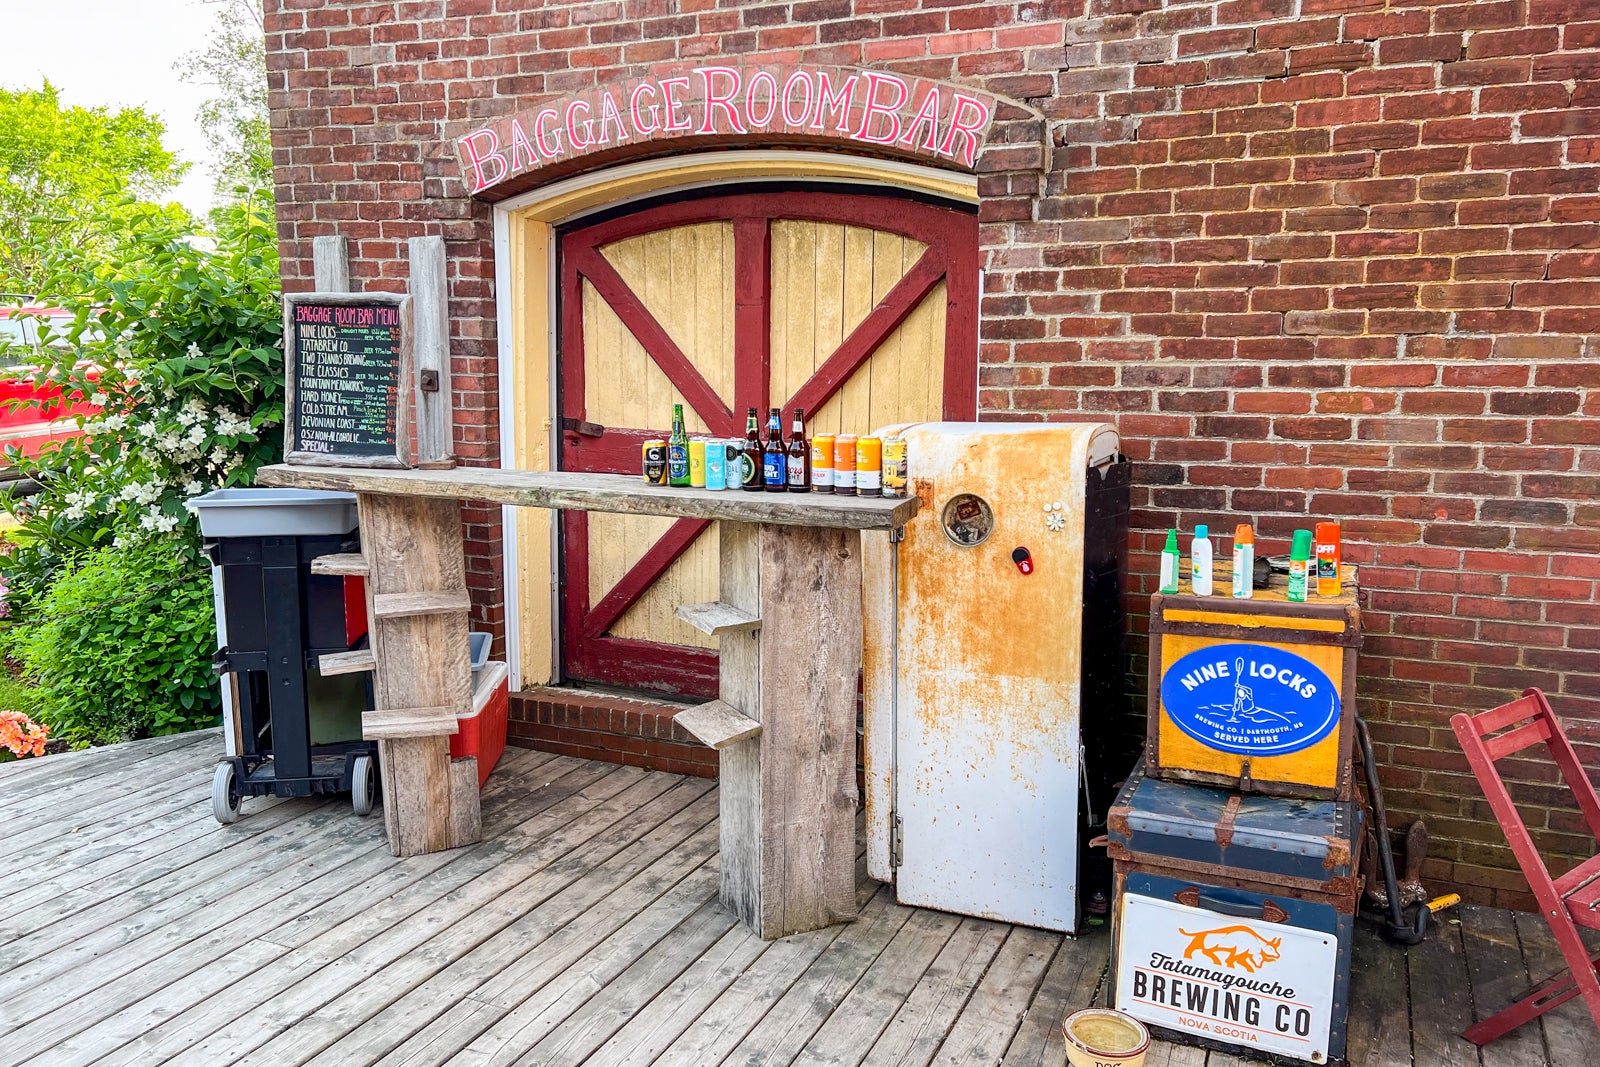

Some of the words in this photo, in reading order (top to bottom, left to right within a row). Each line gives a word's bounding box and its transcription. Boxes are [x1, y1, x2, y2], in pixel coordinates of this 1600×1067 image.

[458, 77, 692, 195] BAGGAGE
[693, 66, 859, 134] ROOM
[850, 71, 989, 168] BAR
[296, 305, 332, 323] BAGGAGE
[335, 307, 356, 324] ROOM
[357, 308, 374, 325] BAR
[376, 307, 398, 325] MENU
[300, 324, 316, 338] NINE
[317, 325, 337, 339] LOCKS
[300, 338, 338, 352] TATABREW
[339, 341, 348, 353] CO
[300, 350, 315, 364] TWO
[317, 352, 343, 365] ISLANDS
[343, 354, 366, 367] BREWING
[300, 363, 315, 377] THE
[317, 365, 349, 379] CLASSICS
[300, 390, 319, 402] HARD
[320, 391, 343, 404] HONEY
[301, 402, 348, 416] COLDSTREAM
[301, 415, 335, 429] DEVONIAN
[336, 418, 355, 429] COAST
[314, 430, 360, 444] NON-ALCOHOLIC
[1180, 661, 1230, 691] NINE
[1249, 660, 1317, 699] LOCKS
[1194, 713, 1225, 730] BREWING
[1214, 731, 1250, 744] SERVED
[1253, 735, 1280, 744] HERE
[1149, 951, 1297, 999] Tatamagouche
[1133, 970, 1261, 1026] BREWING
[1274, 1004, 1311, 1037] CO
[1178, 1016, 1211, 1031] NOVA
[1213, 1025, 1258, 1042] SCOTIA
